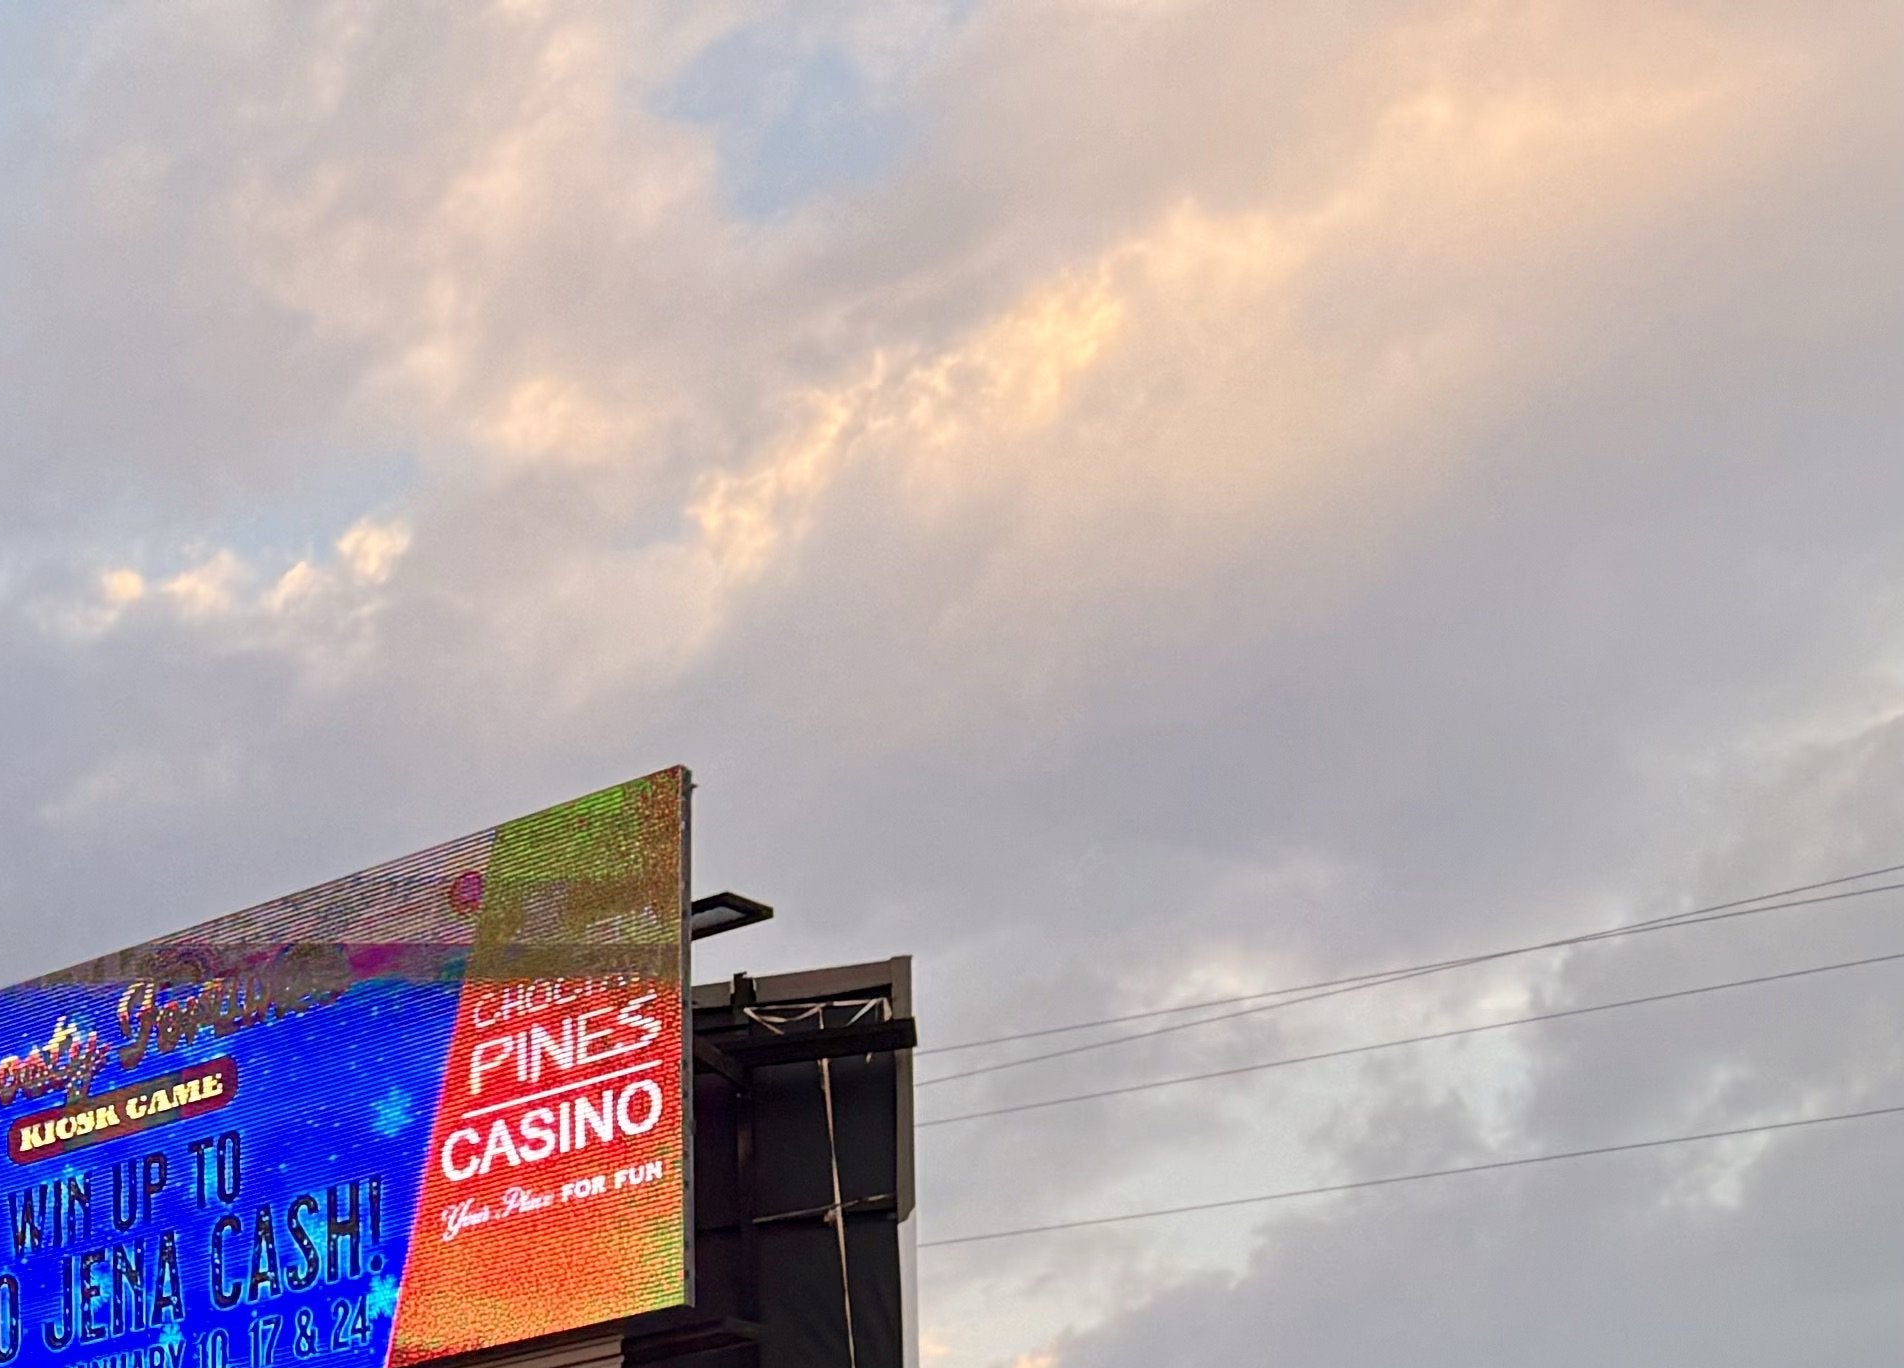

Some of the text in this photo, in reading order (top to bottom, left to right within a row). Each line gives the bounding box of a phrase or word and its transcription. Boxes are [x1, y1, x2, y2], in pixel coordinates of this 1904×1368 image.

[469, 993, 663, 1095] PINES
[19, 1072, 223, 1151] KIOSK GAME
[441, 1079, 663, 1181] CASINO
[8, 1131, 241, 1257] WIN UP TO
[561, 1175, 607, 1202] FOR
[614, 1161, 663, 1189] FUN
[44, 1232, 186, 1352] JENA
[211, 1177, 385, 1310] CASH!
[248, 1314, 283, 1368] 17
[293, 1308, 318, 1359] &
[330, 1298, 371, 1352] 24
